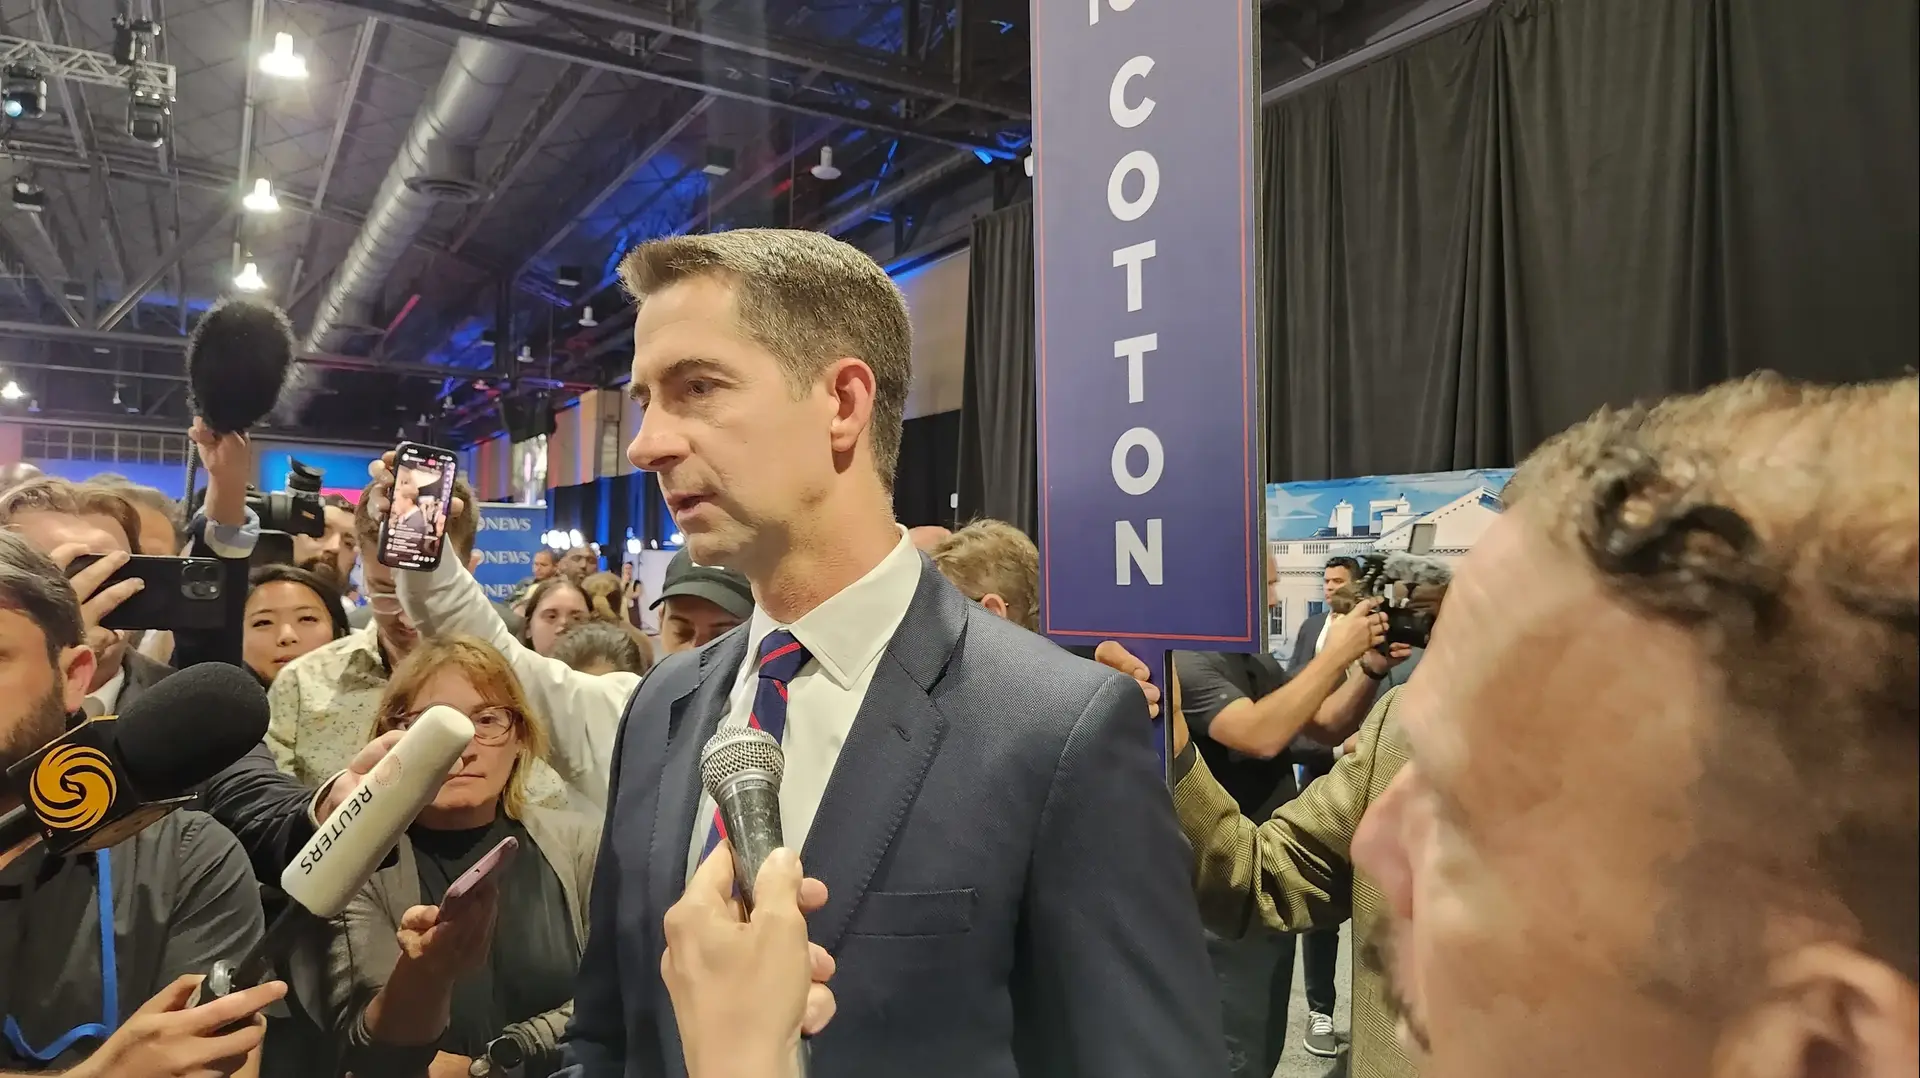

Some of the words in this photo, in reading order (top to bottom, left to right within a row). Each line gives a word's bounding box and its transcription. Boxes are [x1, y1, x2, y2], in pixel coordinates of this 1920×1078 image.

[1107, 55, 1164, 586] COTTON
[485, 516, 531, 531] NEWS
[484, 550, 531, 565] NEWS
[301, 785, 373, 875] REUTERS
